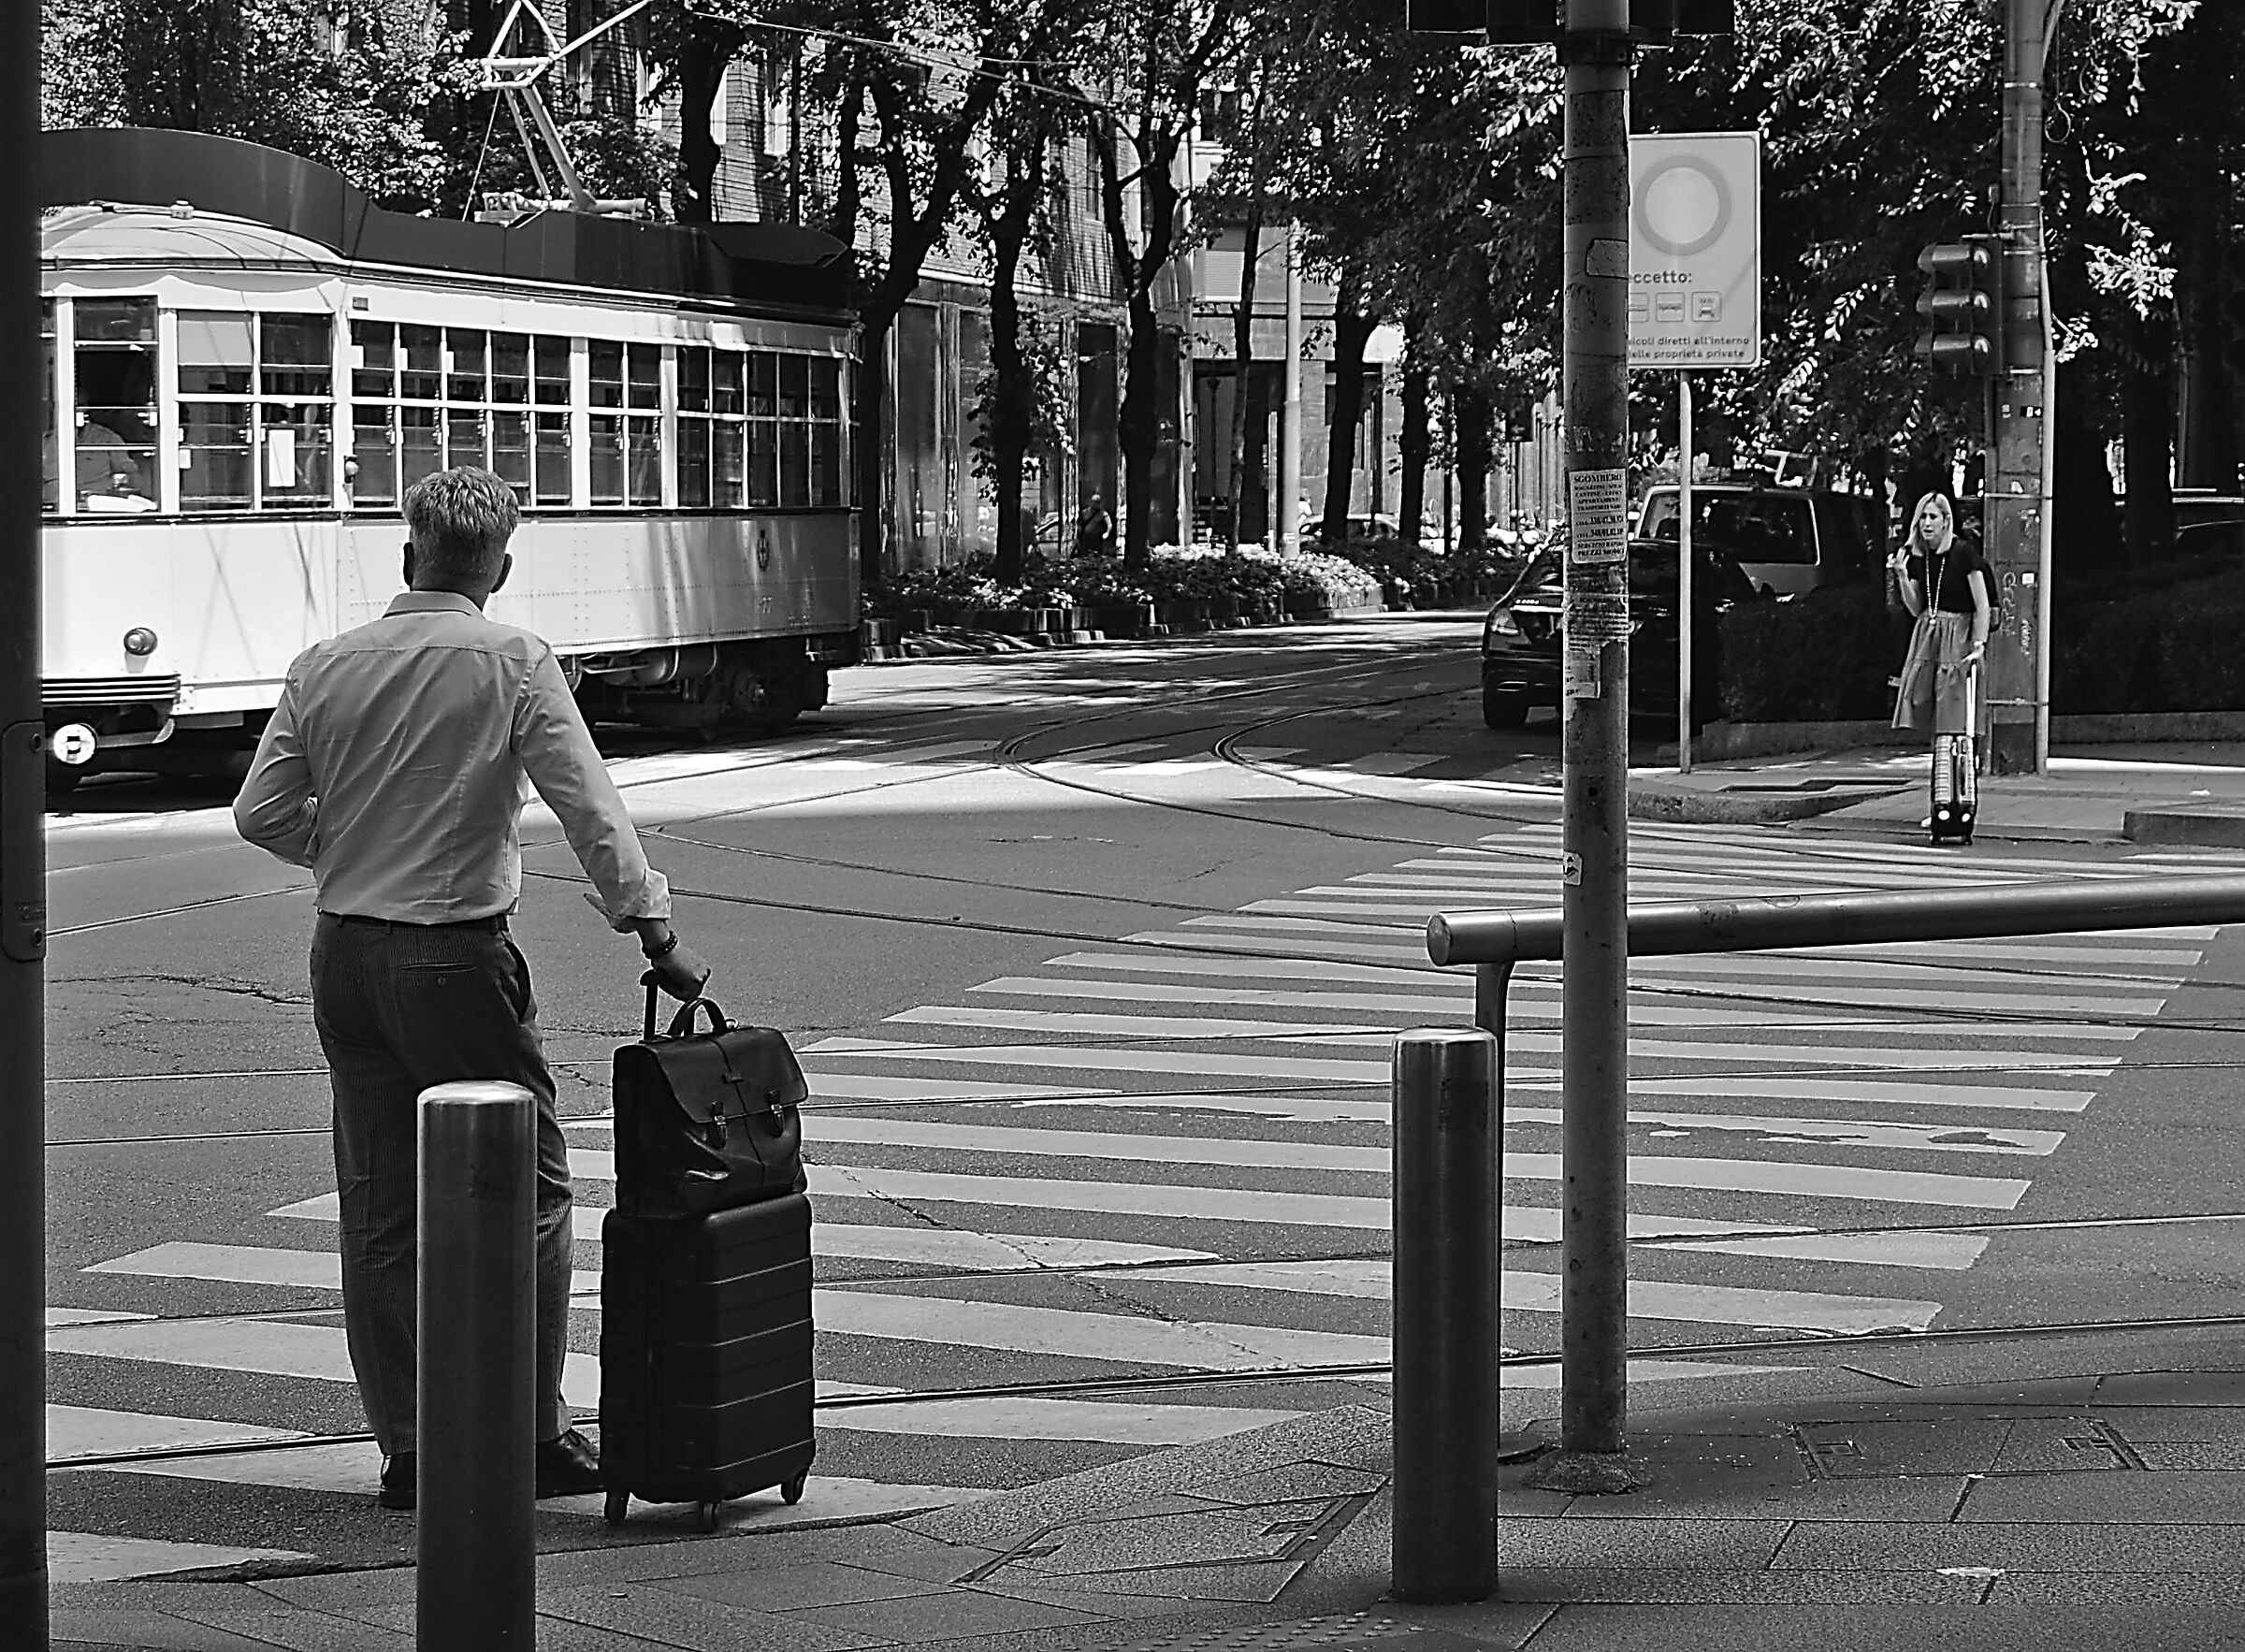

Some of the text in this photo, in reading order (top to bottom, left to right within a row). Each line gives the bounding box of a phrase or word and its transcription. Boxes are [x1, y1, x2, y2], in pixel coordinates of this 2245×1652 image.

[1658, 337, 1690, 345] diretti
[1706, 349, 1745, 359] private
[1573, 474, 1622, 483] SGOMBERO
